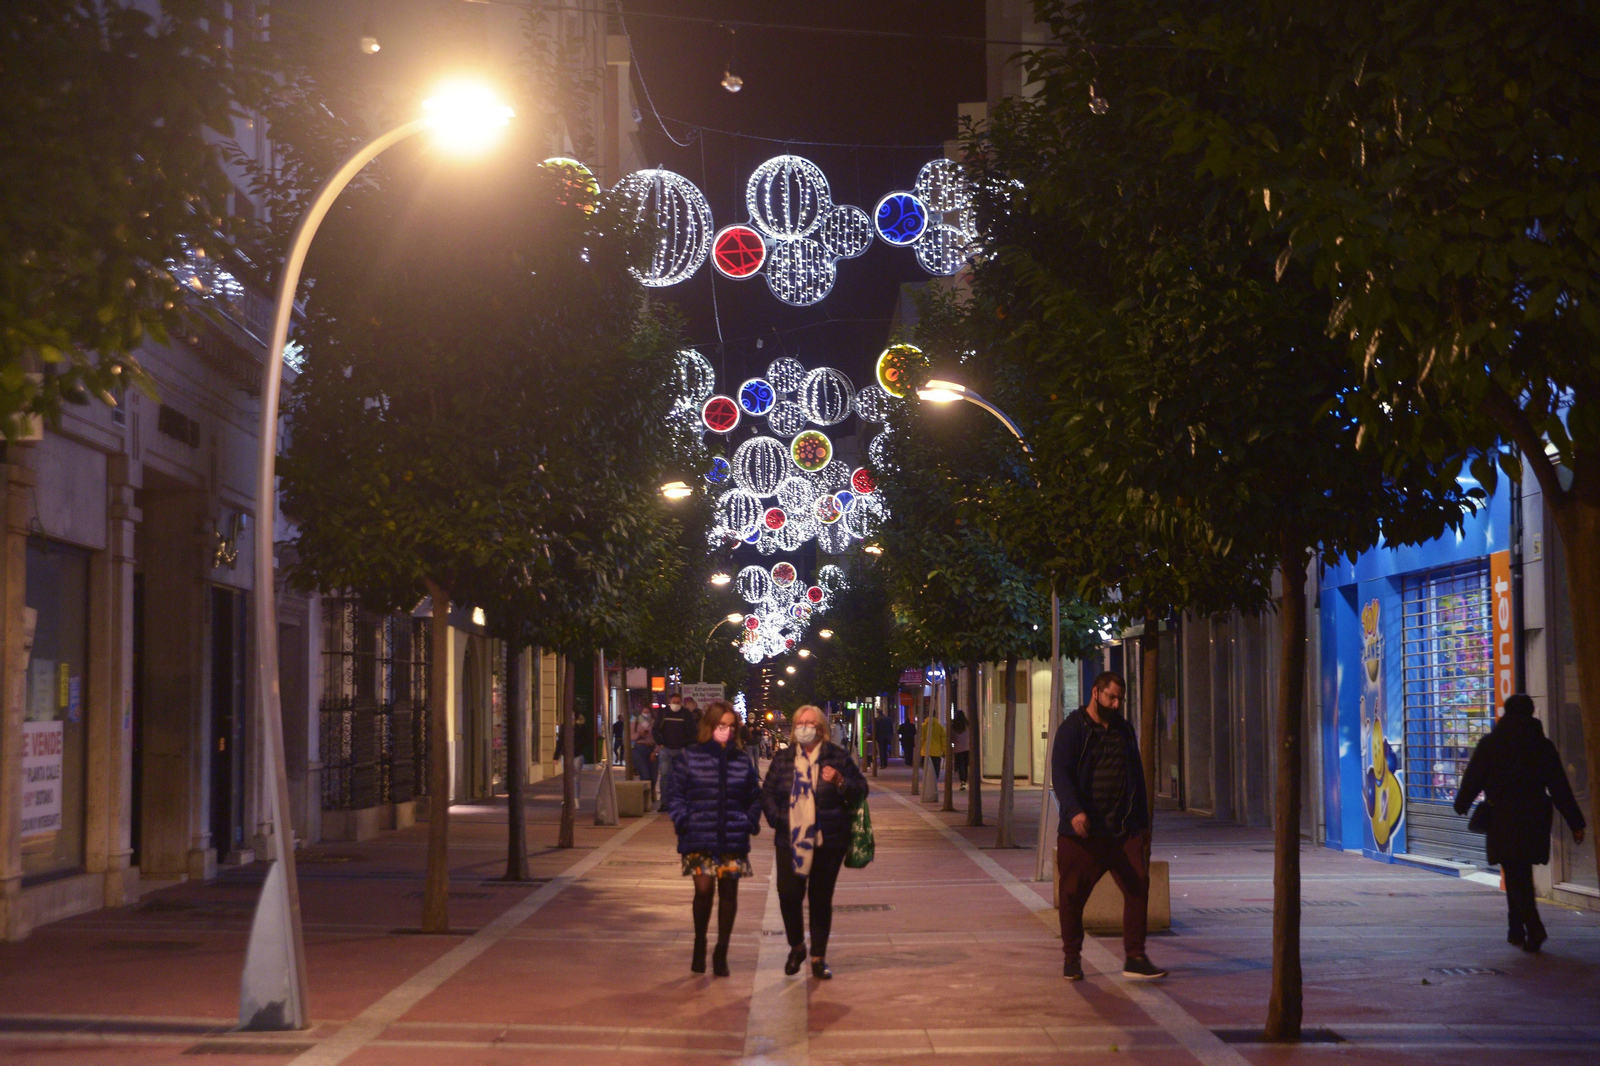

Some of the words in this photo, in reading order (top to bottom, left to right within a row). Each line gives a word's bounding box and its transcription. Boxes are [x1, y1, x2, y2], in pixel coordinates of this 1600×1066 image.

[1361, 599, 1380, 639] TOY
[1360, 635, 1385, 663] PLANET
[32, 731, 61, 756] VENDE
